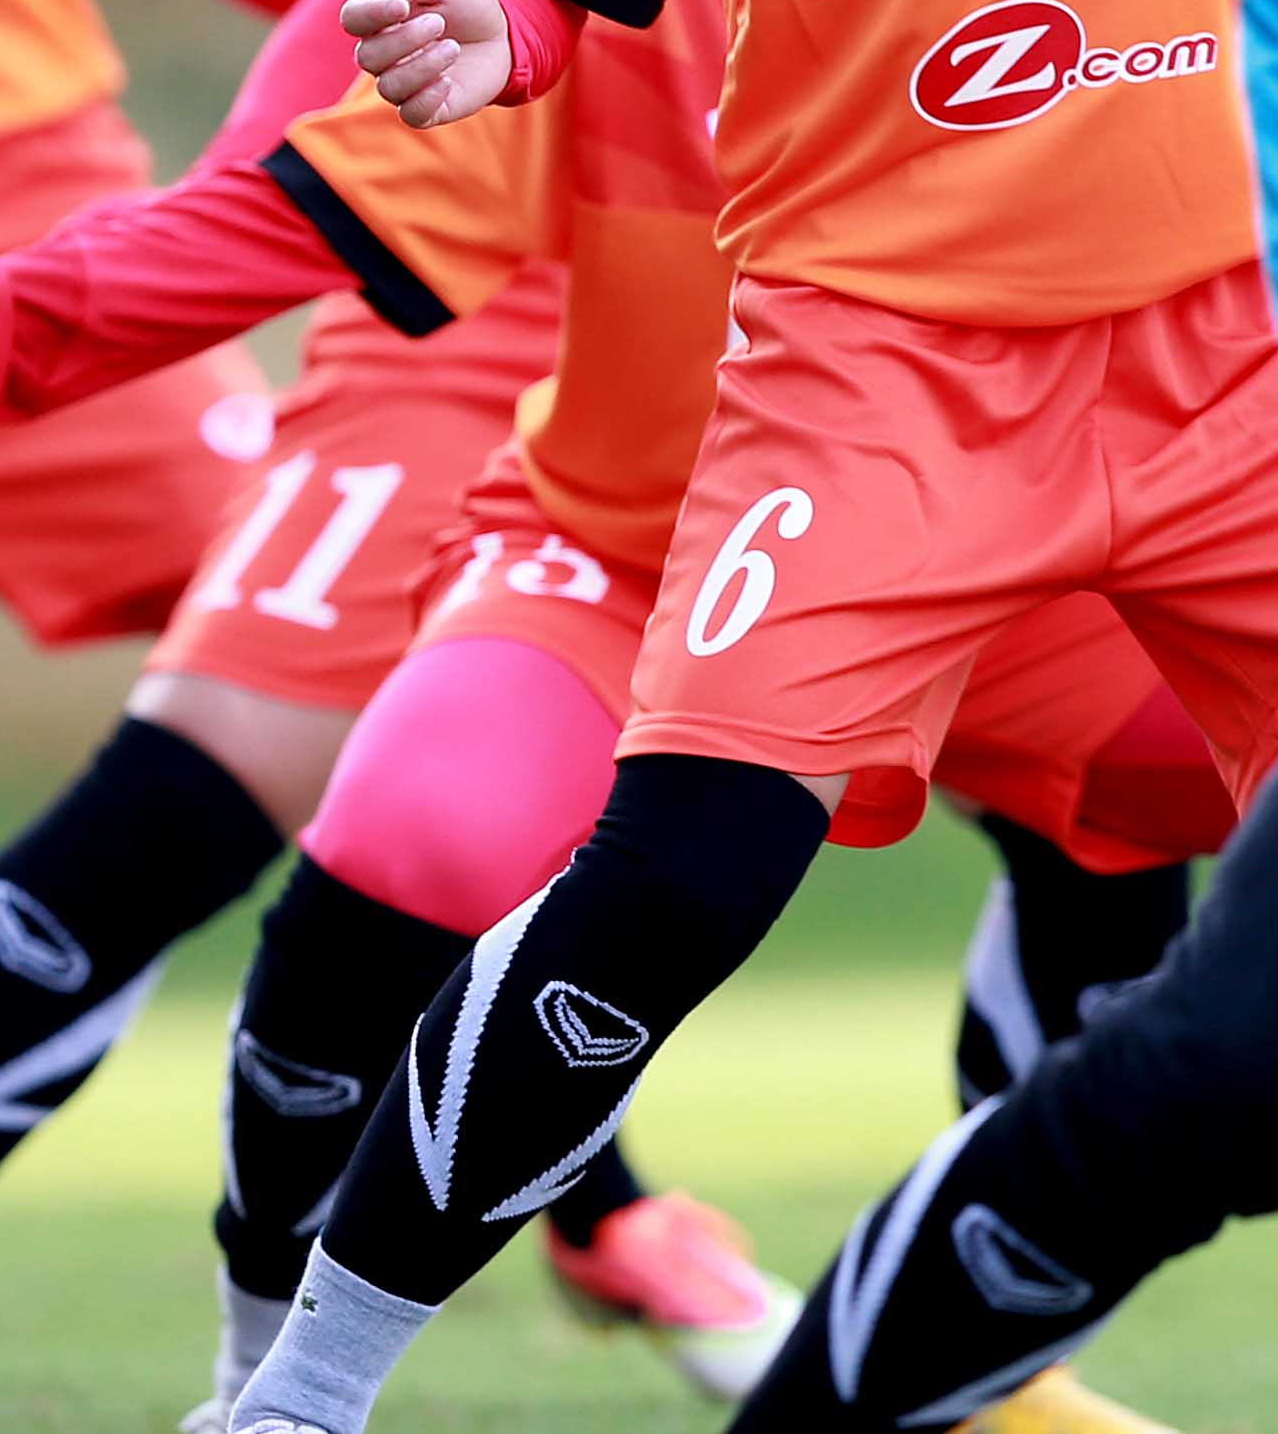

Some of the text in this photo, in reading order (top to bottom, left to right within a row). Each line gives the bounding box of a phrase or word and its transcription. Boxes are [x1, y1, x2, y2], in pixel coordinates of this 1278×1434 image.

[941, 22, 1218, 109] Z.com
[193, 448, 406, 631] 11
[685, 485, 816, 659] 6
